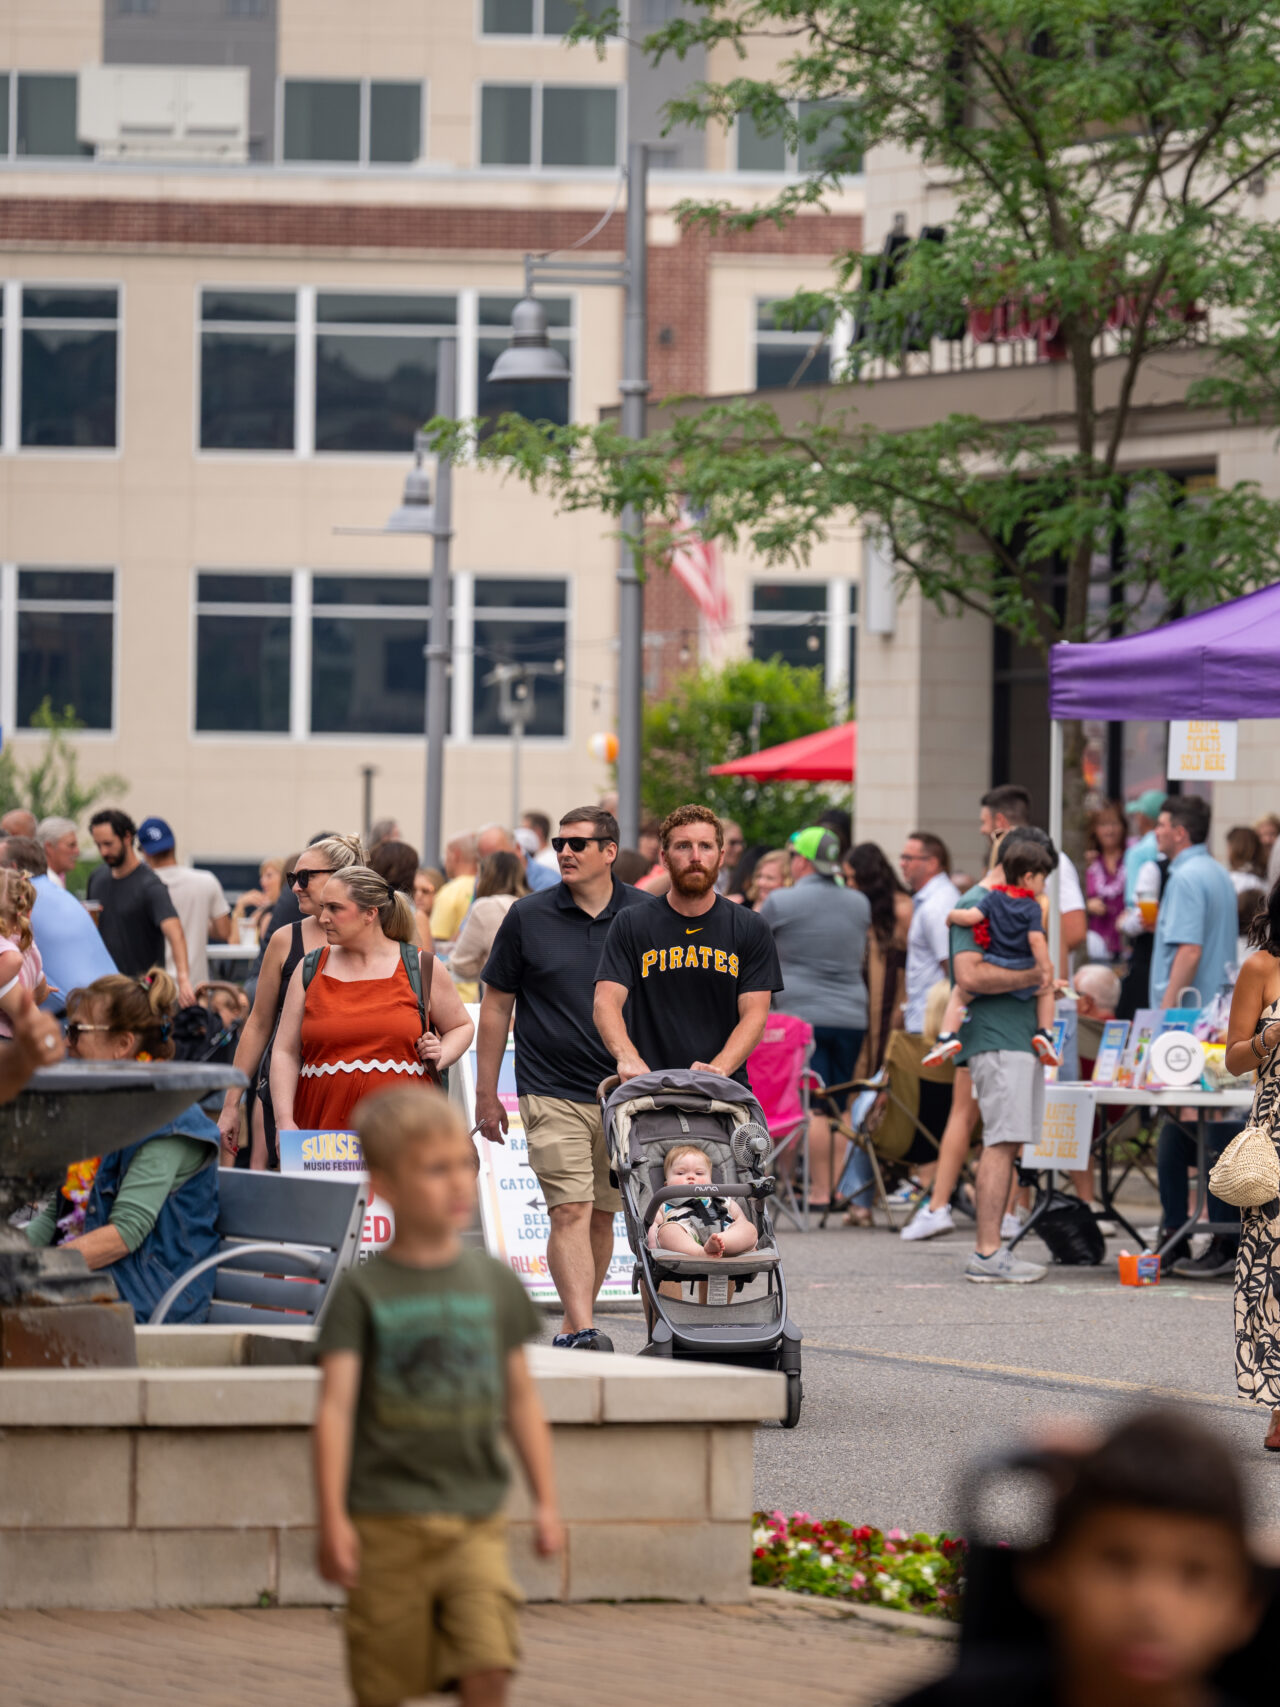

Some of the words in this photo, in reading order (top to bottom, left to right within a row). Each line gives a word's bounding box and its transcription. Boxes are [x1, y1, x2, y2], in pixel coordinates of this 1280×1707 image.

[1187, 734, 1221, 752] TICKETS
[1180, 753, 1201, 772] SOLD
[1203, 753, 1227, 772] HERE
[641, 944, 739, 979] PIRATES
[302, 1133, 364, 1160] SUNSE
[1056, 1141, 1080, 1158] HERE
[303, 1161, 331, 1171] MUSIC
[332, 1161, 369, 1172] FESTIVA
[694, 1185, 720, 1193] nuna
[517, 1227, 550, 1241] LOCA
